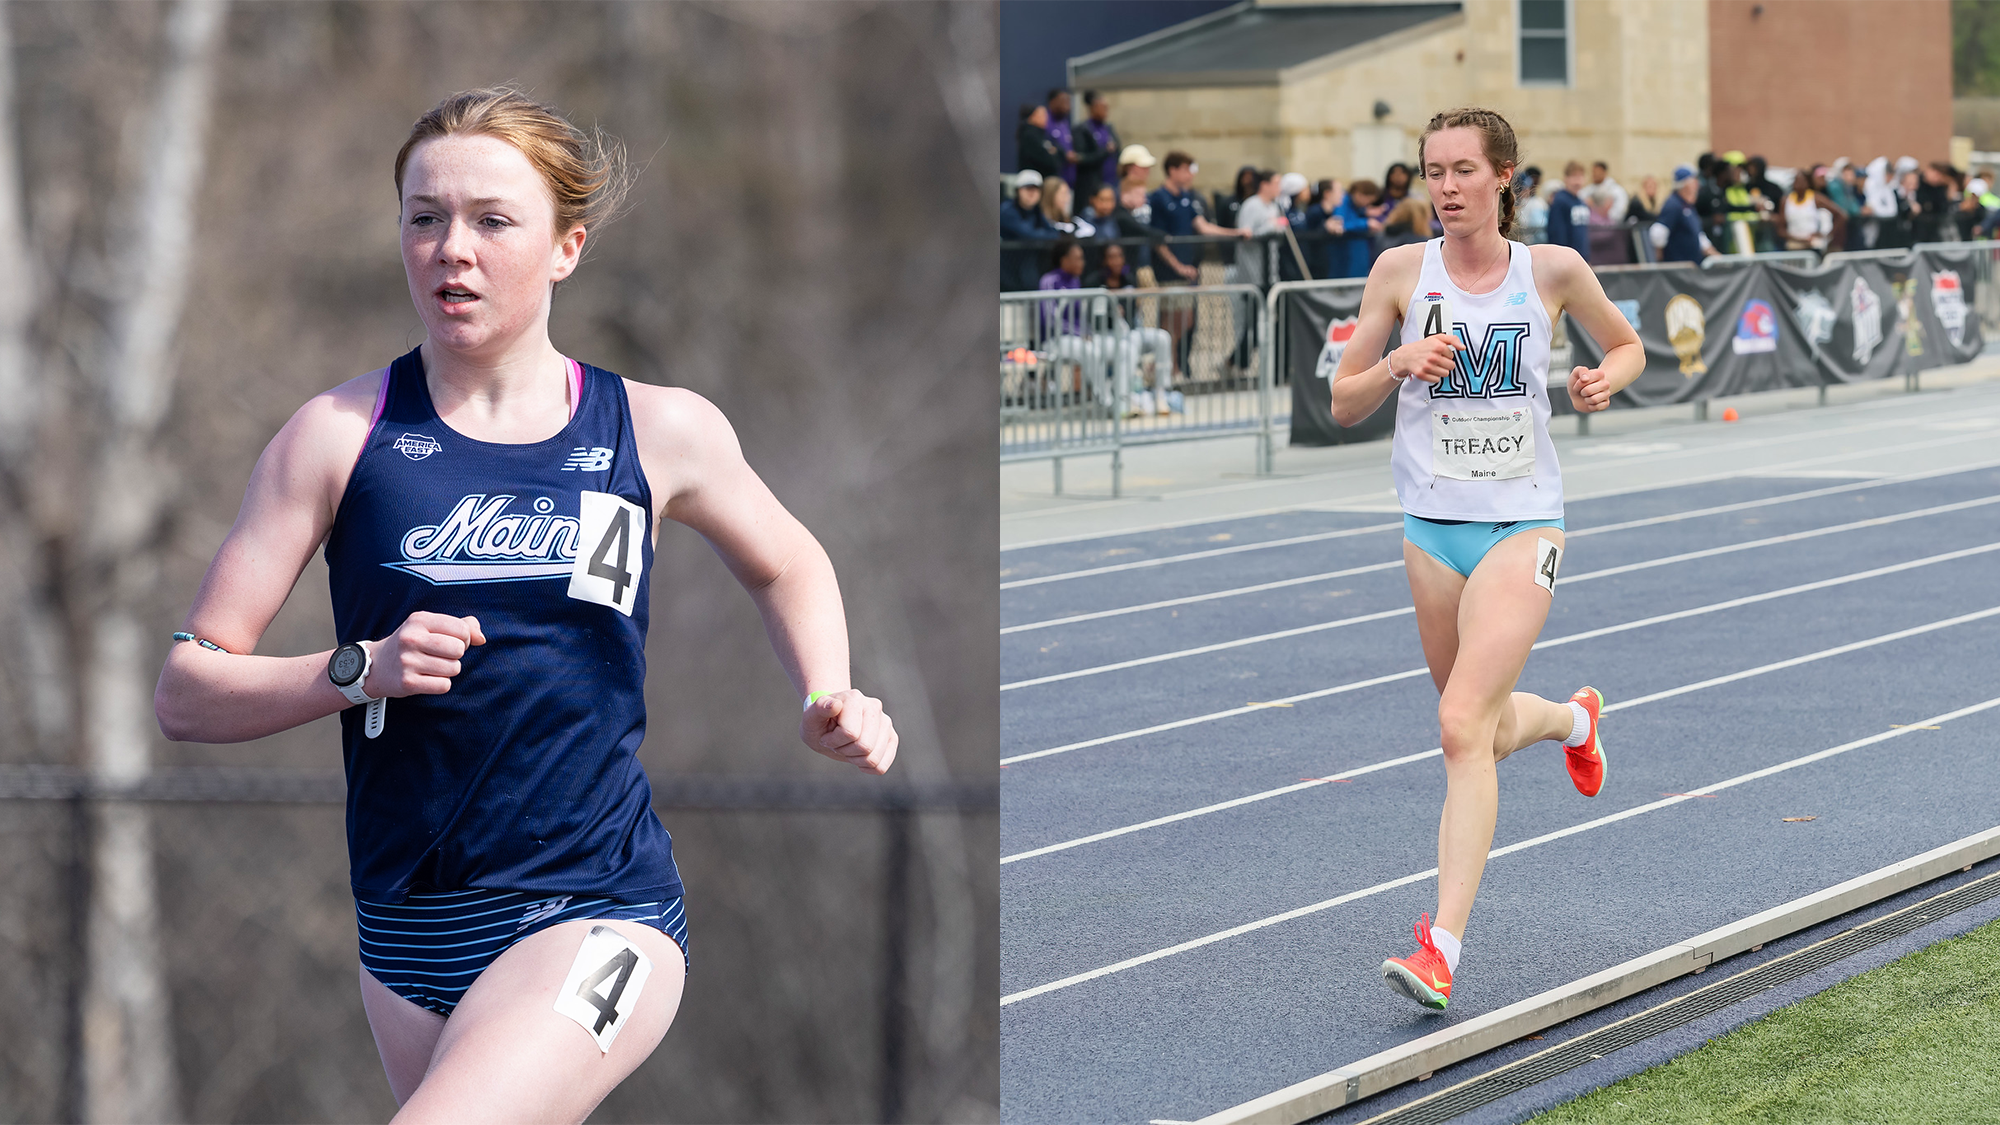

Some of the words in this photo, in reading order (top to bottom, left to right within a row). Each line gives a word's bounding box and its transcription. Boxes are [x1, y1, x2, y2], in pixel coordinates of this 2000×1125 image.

[1424, 303, 1446, 339] 4
[1429, 322, 1531, 400] M
[1473, 415, 1511, 423] Championship
[394, 439, 442, 451] AMERICA
[404, 446, 429, 454] EAST
[561, 446, 614, 472] NB
[1441, 435, 1524, 455] TREACY
[1471, 470, 1497, 478] Maine
[401, 494, 581, 562] Main
[587, 505, 632, 605] 4
[1541, 546, 1557, 589] 4
[576, 947, 639, 1036] 4
